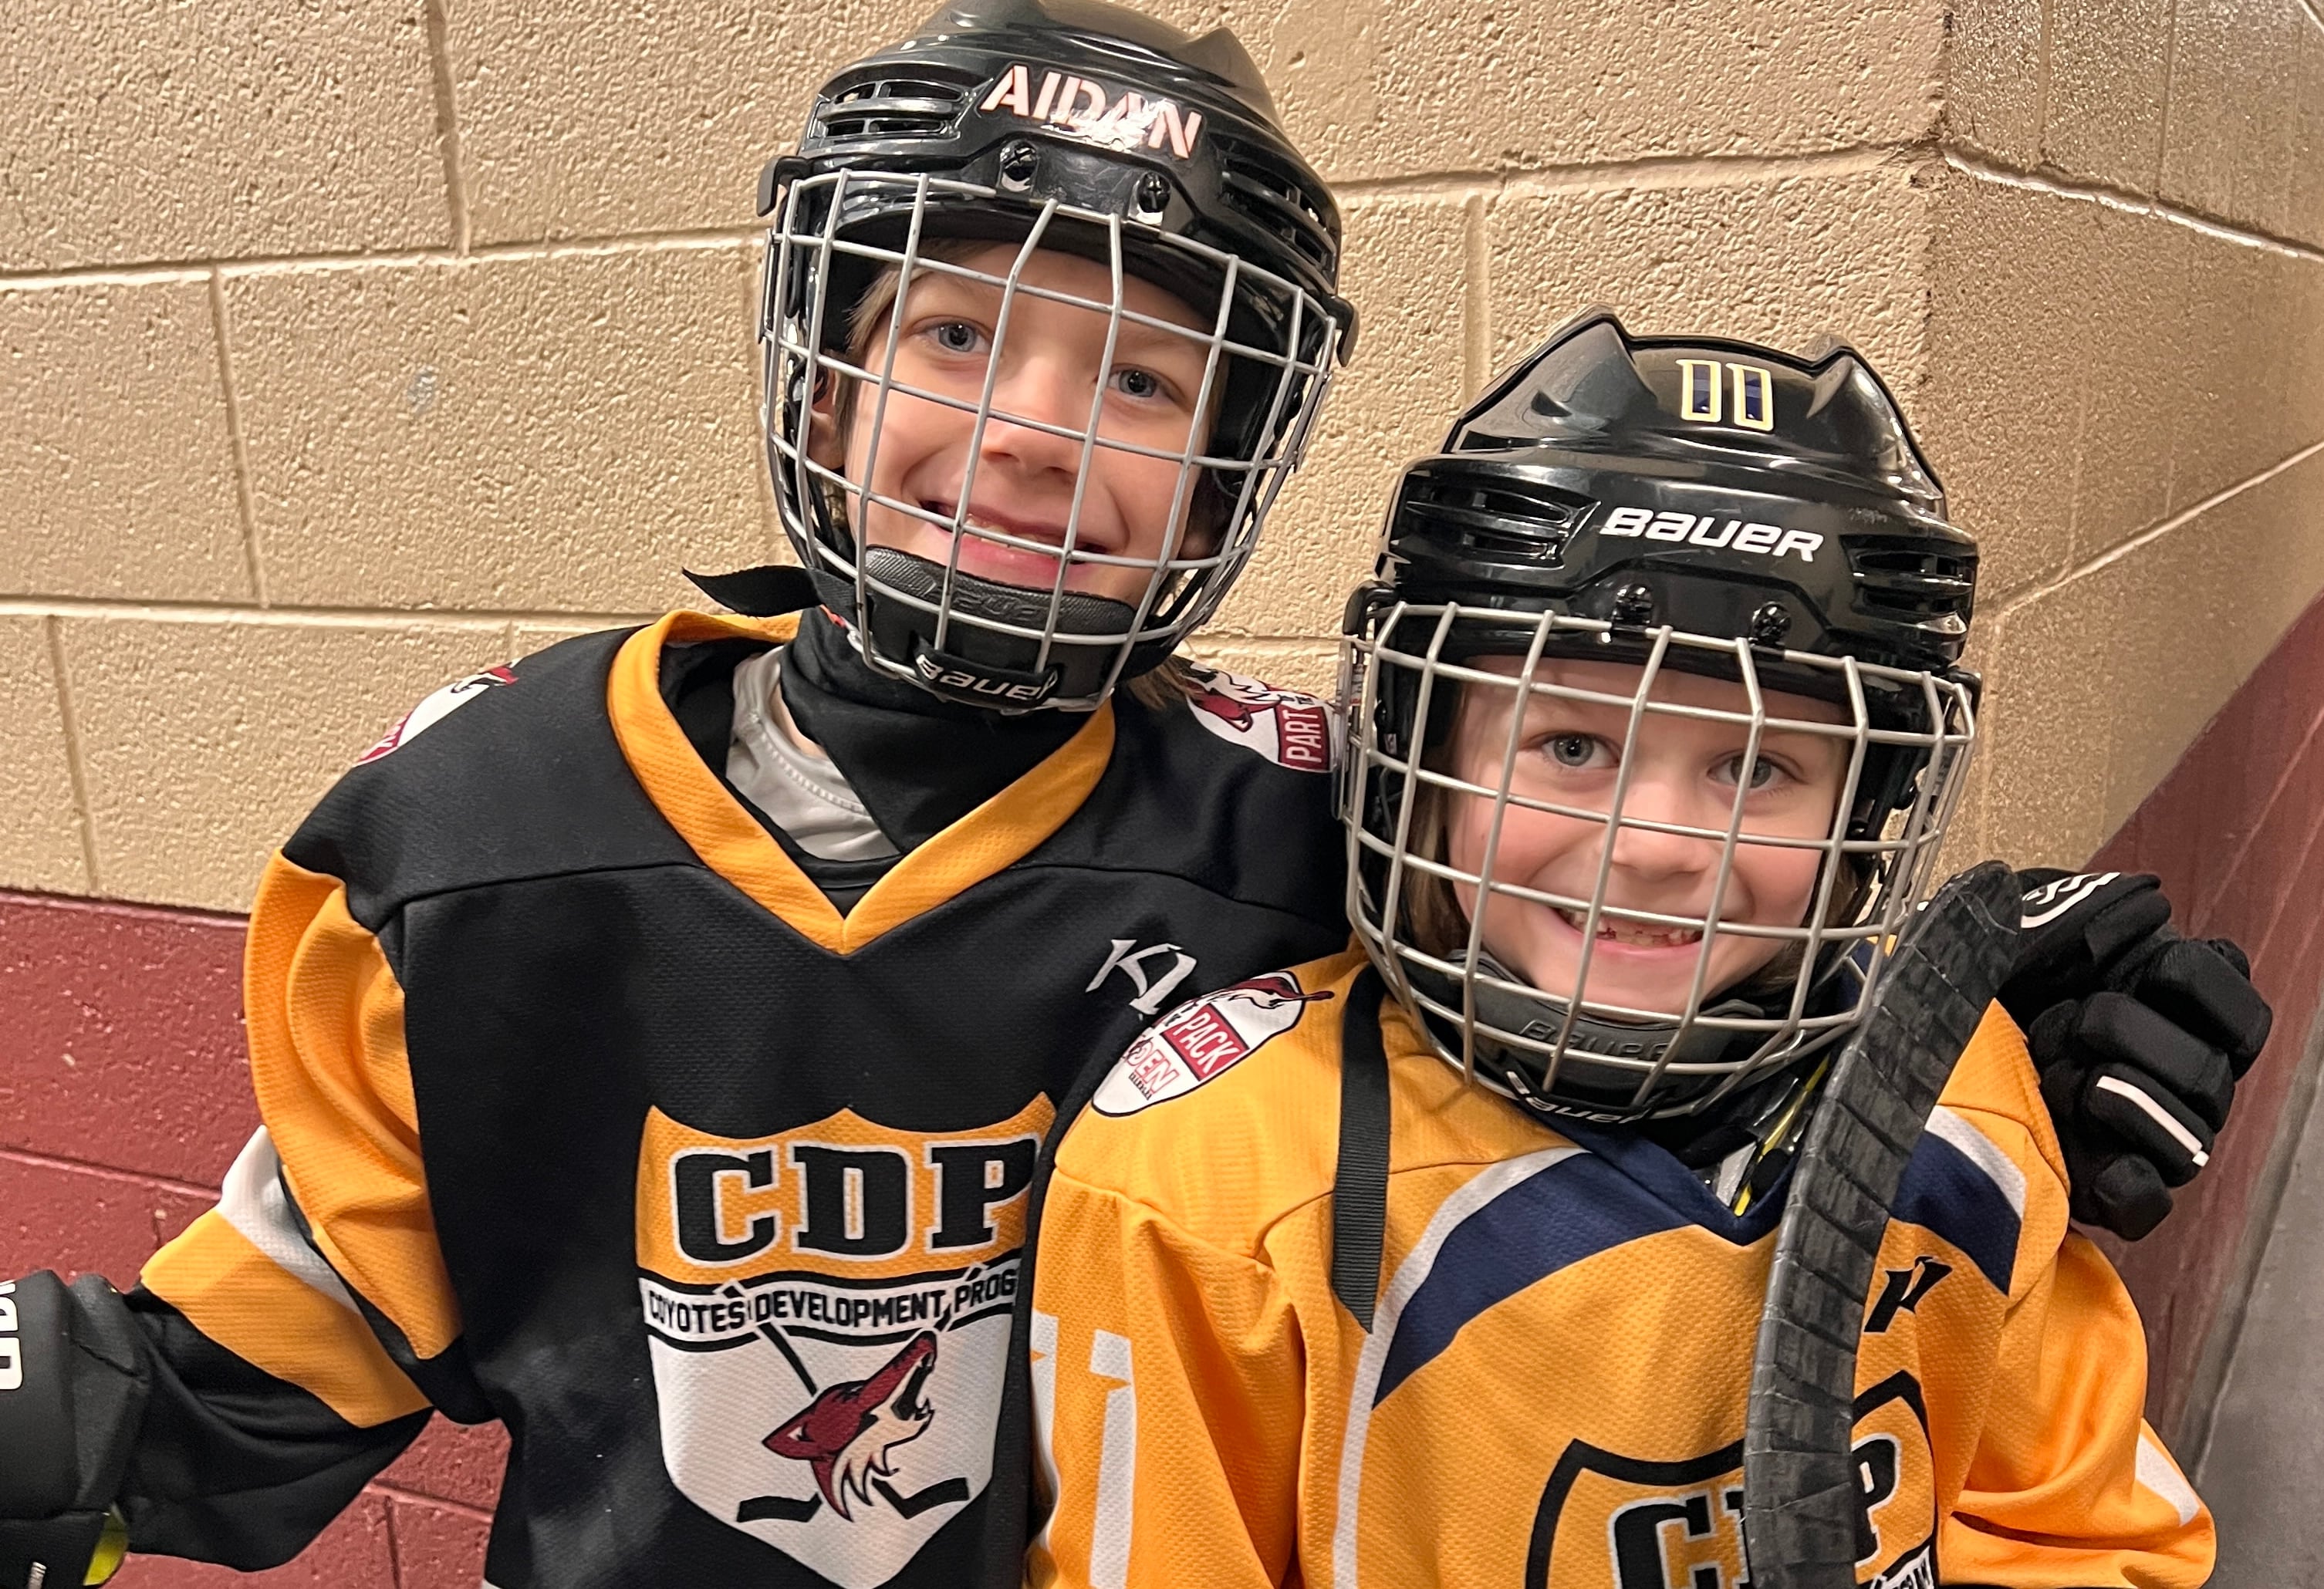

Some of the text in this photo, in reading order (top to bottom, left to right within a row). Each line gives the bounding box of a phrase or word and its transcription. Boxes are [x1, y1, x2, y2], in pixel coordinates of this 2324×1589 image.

[979, 64, 1204, 160] AIDAN
[1599, 507, 1824, 562] BAUER
[1281, 709, 1322, 764] PART
[1172, 1012, 1241, 1074] PACK
[670, 1134, 1039, 1267] CDP
[755, 1290, 946, 1328] DEVELOPMENT
[1608, 1432, 1902, 1589] CP
